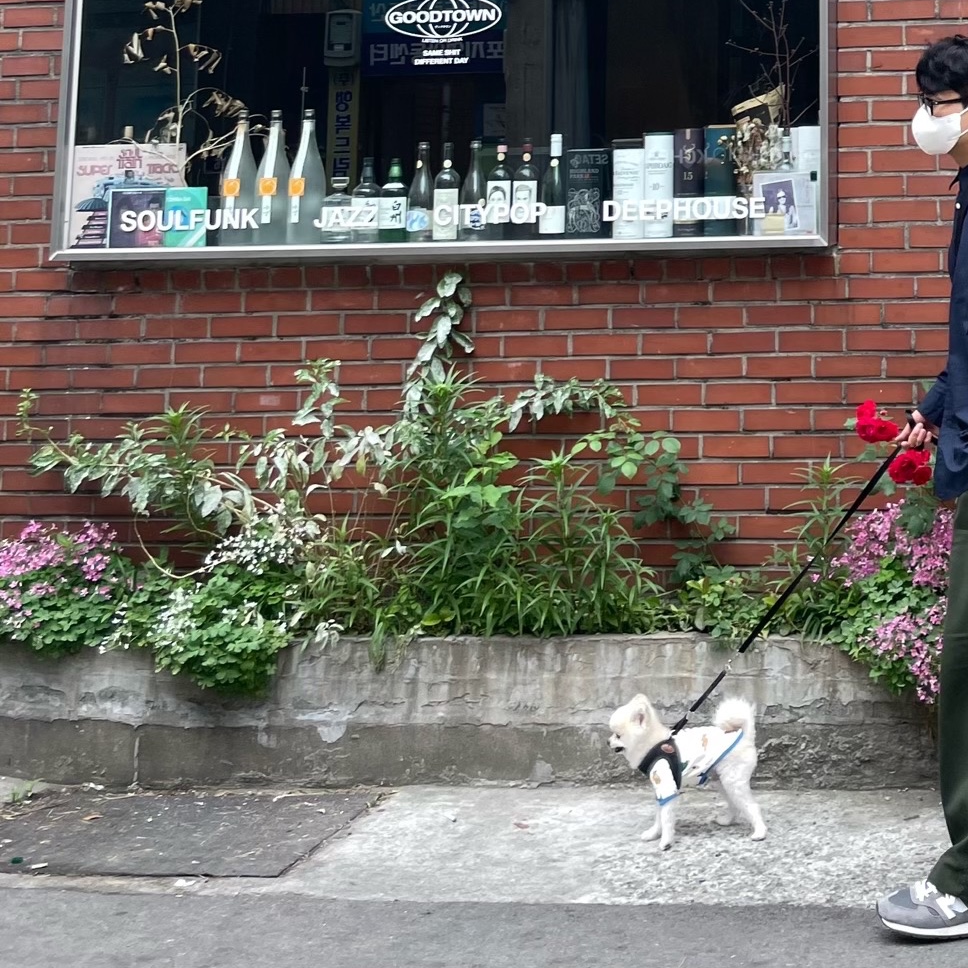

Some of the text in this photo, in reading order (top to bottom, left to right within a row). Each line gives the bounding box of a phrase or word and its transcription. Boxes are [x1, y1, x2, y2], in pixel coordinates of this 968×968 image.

[389, 8, 496, 24] GOODTOWN
[414, 56, 469, 65] DIFFERENT DAY
[422, 48, 461, 57] SAME SHIT
[313, 206, 379, 228] JAZZ
[602, 197, 766, 222] DEEPHOUSE
[120, 207, 259, 232] SOULFUNK
